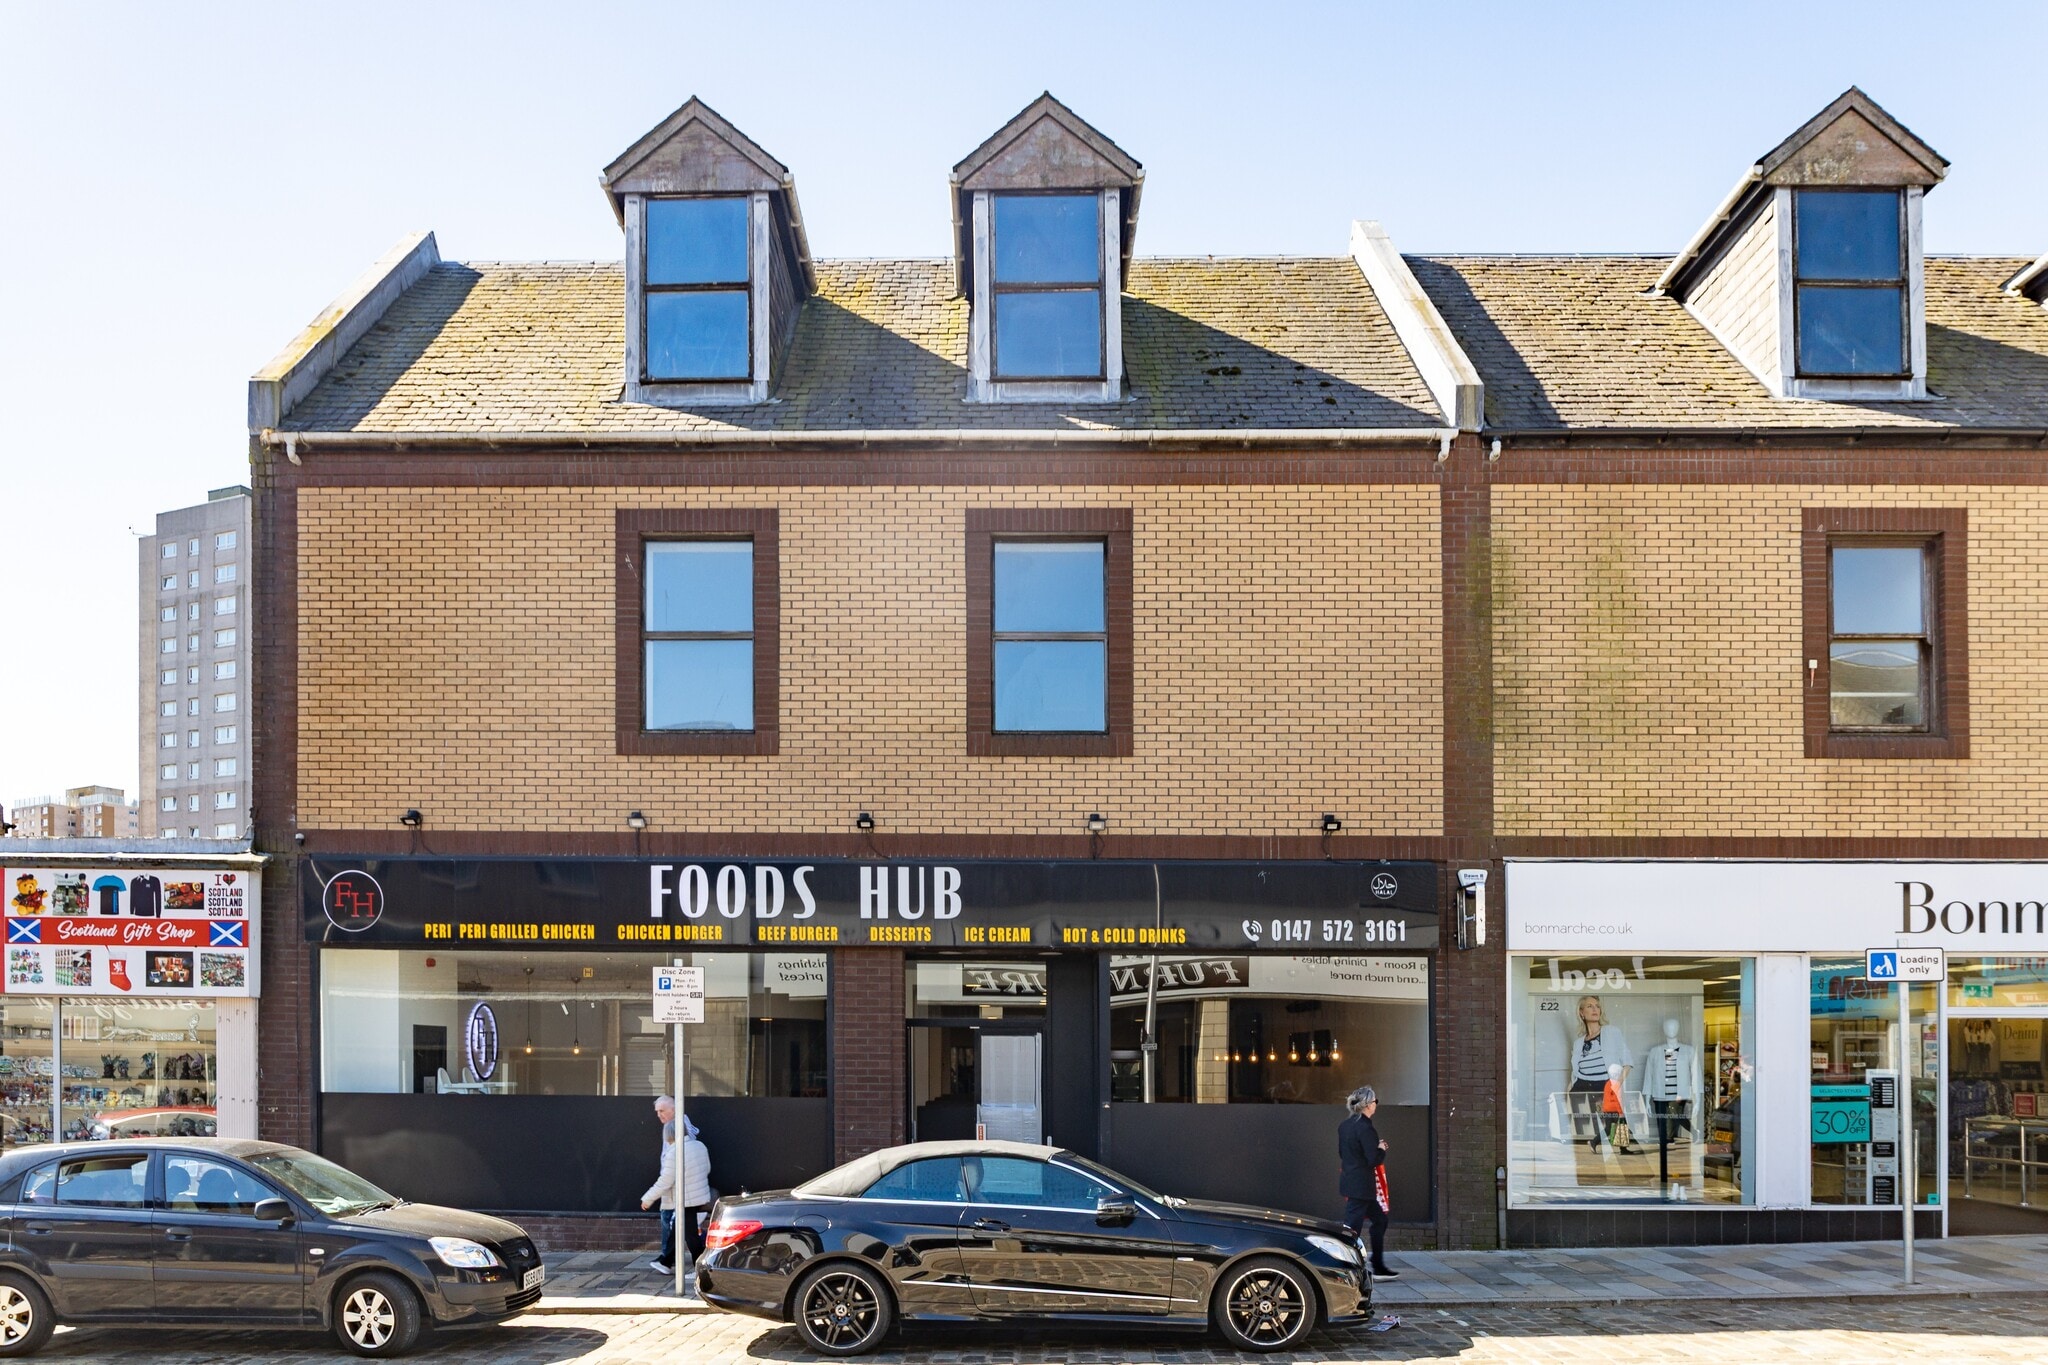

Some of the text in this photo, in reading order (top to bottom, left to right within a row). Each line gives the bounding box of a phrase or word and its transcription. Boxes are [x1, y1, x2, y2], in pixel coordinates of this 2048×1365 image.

[215, 874, 221, 886] I
[208, 888, 243, 897] SCOTLAND
[650, 864, 962, 920] FOODS HUB
[208, 898, 243, 907] SCOTLAND
[208, 908, 243, 917] SCOTLAND
[57, 919, 196, 943] Scotland Gift Shop
[424, 923, 595, 940] PERI PERI GRILLED CHICKEN
[617, 924, 723, 941] CHICKEN BURGER
[758, 925, 839, 942] BEEF BURGER
[869, 926, 932, 942] DESSERTS
[964, 926, 1031, 943] ICE CREAM
[1062, 927, 1187, 944] HOT & COLD DRINKS
[1271, 919, 1406, 942] 0147 572 3161
[1525, 922, 1633, 935] bonmarche.co.uk
[1900, 956, 1939, 964] Loading
[1909, 966, 1930, 975] only
[1540, 1002, 1560, 1011] £22
[2003, 1024, 2039, 1040] Denim
[1814, 1109, 1867, 1135] 30%
[1849, 1126, 1867, 1134] OFF
